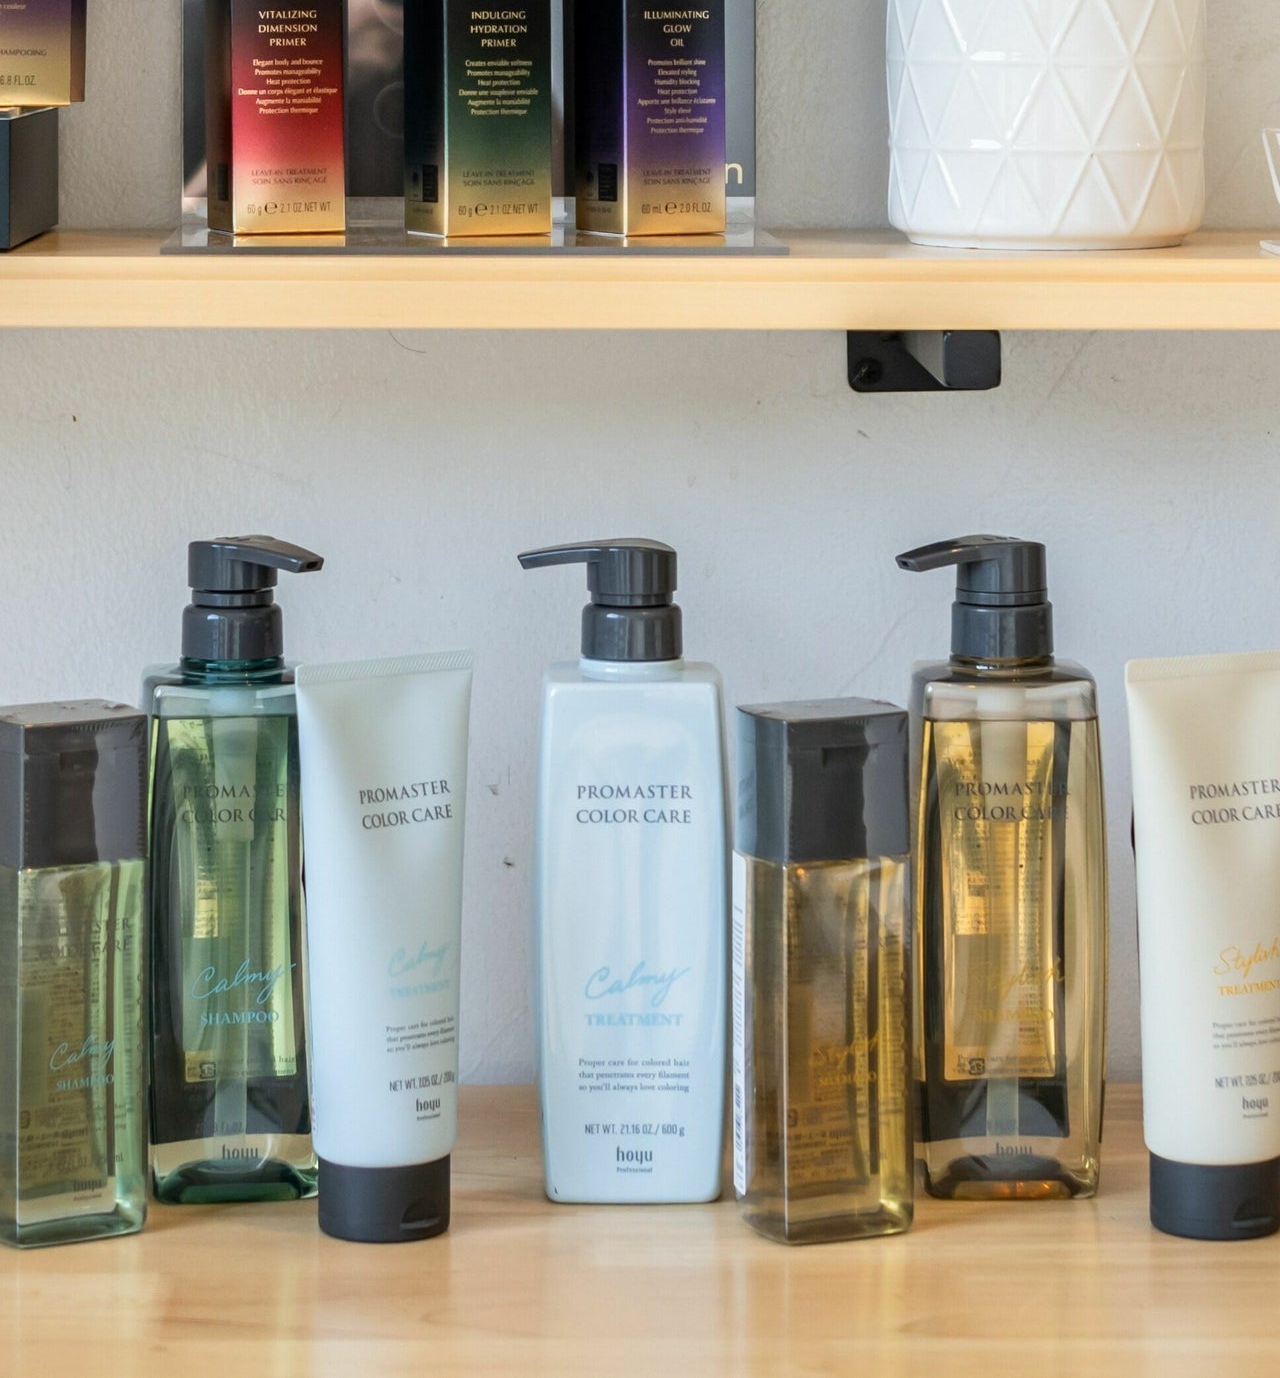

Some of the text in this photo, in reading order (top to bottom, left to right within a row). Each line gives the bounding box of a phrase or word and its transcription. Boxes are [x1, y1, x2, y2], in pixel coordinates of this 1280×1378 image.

[258, 10, 317, 20] VITALIZING
[471, 10, 526, 20] INDULGING
[644, 10, 710, 20] ILLUMINATING
[258, 24, 318, 33] DIMENSION
[470, 25, 527, 34] HYDRATION
[663, 24, 692, 33] GLOW
[269, 37, 307, 47] PRIMER
[481, 38, 517, 47] PRIMER
[670, 38, 685, 47] OIL
[0, 75, 12, 85] 6.8
[359, 779, 451, 805] PROMASTER
[576, 784, 693, 800] PROMASTER
[362, 803, 453, 830] COLOR CARE
[576, 809, 692, 824] COLOR CARE
[954, 806, 1018, 821] COLOR
[1192, 806, 1241, 826] COLOR
[192, 959, 297, 1005] Calmy
[585, 960, 692, 1007] Calmy
[200, 1010, 280, 1026] SHAMPOO
[585, 1013, 683, 1027] TREATMENT
[578, 1058, 690, 1068] Proper care for colored hair
[579, 1071, 594, 1079] that
[636, 1072, 656, 1080] every
[658, 1071, 690, 1079] filament
[389, 1080, 403, 1093] NET
[613, 1083, 690, 1093] always love coloring
[416, 1097, 441, 1113] hoyu
[1242, 1096, 1269, 1110] hoyu
[584, 1124, 678, 1135] NET 21.16 600
[616, 1145, 653, 1165] hoyu
